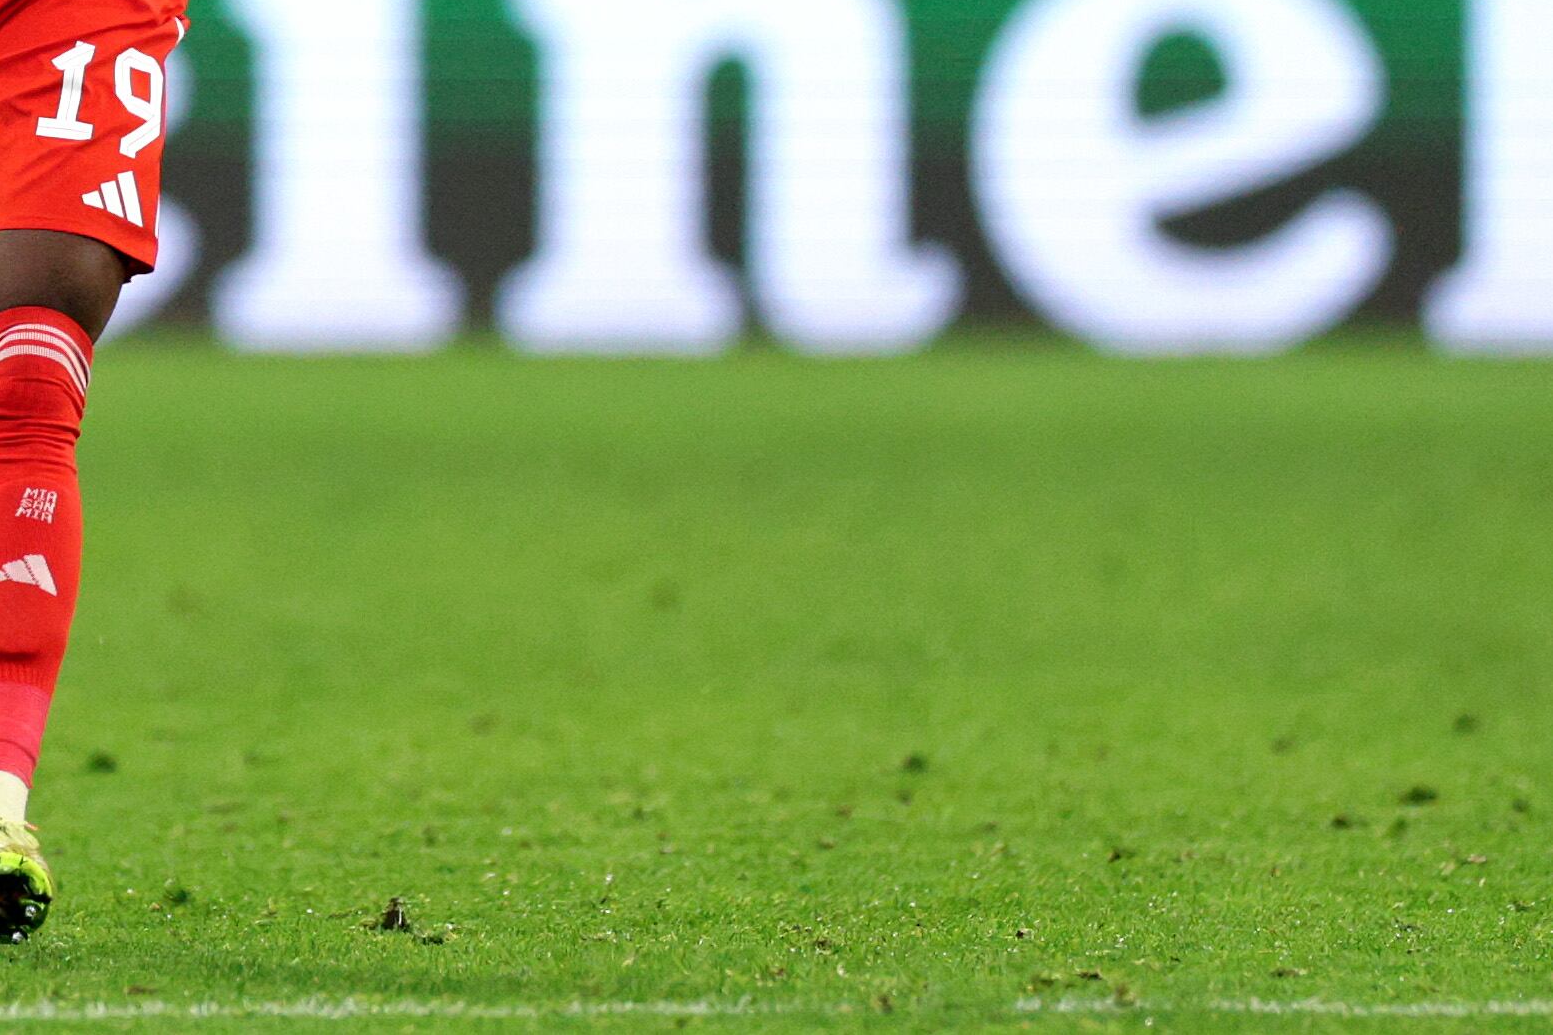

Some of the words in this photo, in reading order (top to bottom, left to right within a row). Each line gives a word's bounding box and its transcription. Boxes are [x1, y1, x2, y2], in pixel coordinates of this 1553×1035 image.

[35, 40, 164, 160] 19
[23, 487, 57, 504] MIA
[15, 506, 53, 524] MIA
